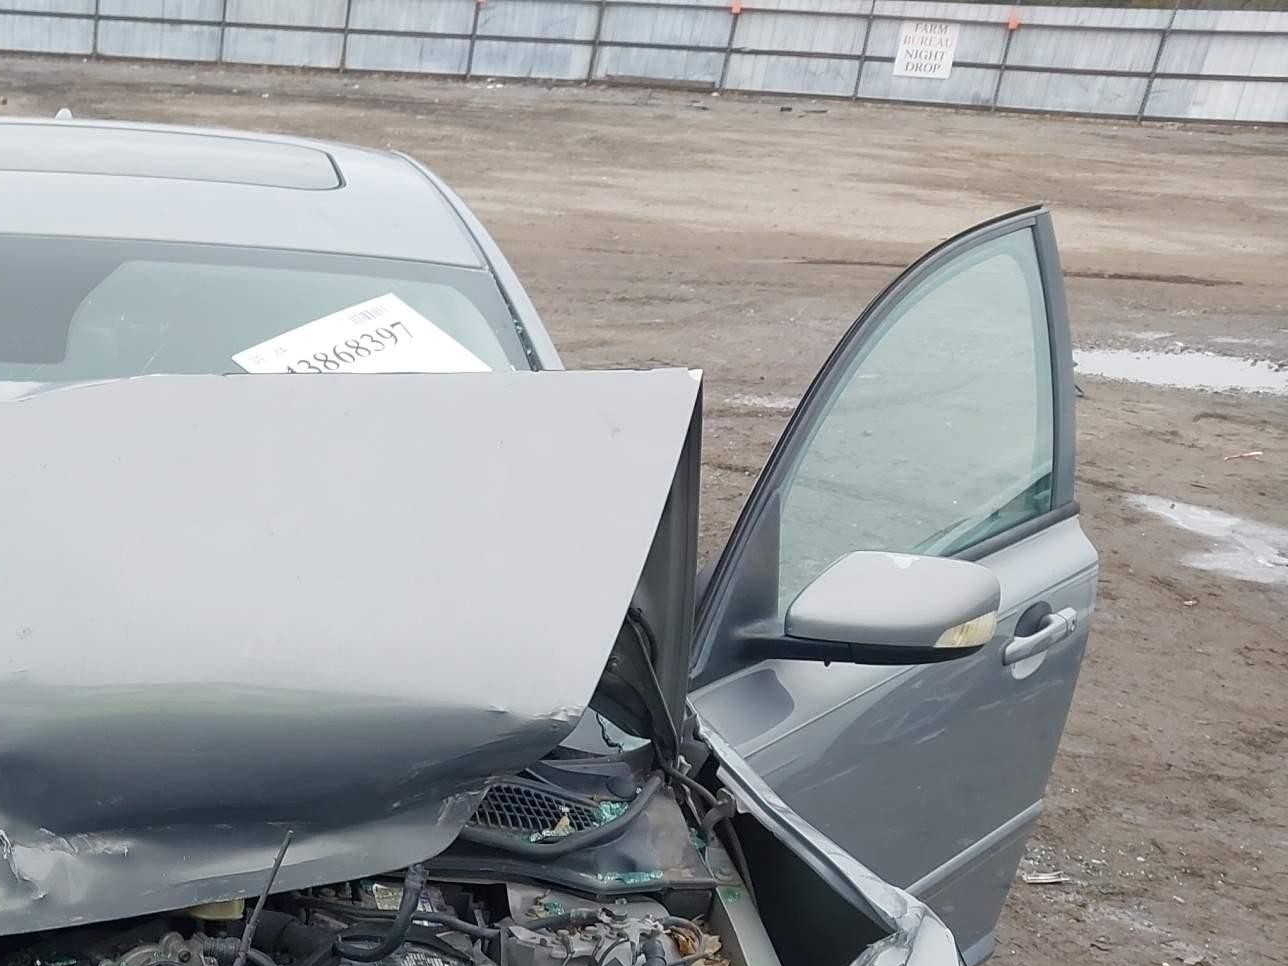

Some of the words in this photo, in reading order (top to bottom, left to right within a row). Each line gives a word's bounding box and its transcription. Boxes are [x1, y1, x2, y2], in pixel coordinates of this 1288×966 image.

[914, 23, 950, 35] FARM
[903, 35, 952, 48] BUREAU
[904, 49, 945, 62] NIGHT
[905, 61, 941, 73] DROP
